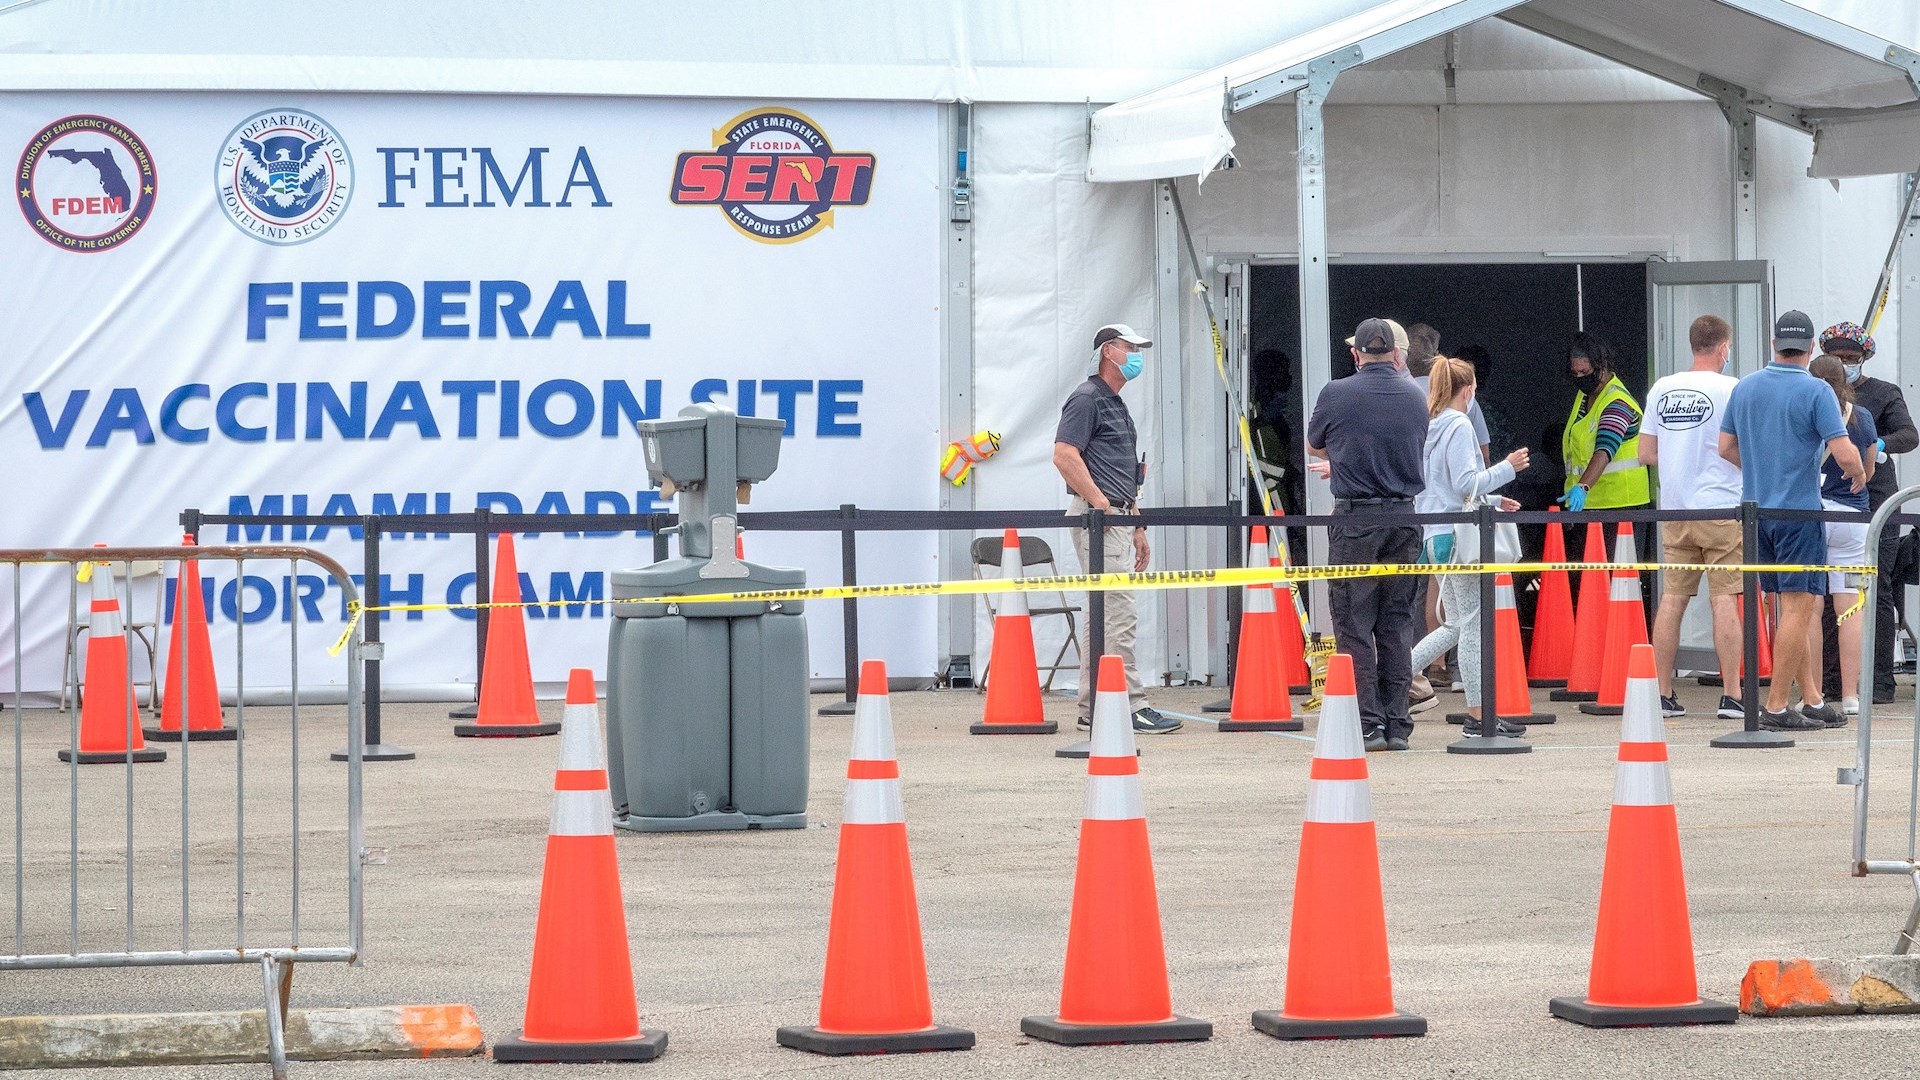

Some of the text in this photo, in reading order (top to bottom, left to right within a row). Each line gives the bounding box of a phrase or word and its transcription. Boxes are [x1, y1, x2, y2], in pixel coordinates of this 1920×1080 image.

[21, 119, 152, 180] DIVISION OF EMERGENCY MANAGEMENT
[222, 115, 347, 168] U.S. DEPARTMENT OF
[731, 117, 824, 149] STATE EMERGENCY
[750, 141, 801, 150] FLORIDA
[376, 146, 613, 208] FEMA
[678, 155, 872, 202] SERT
[52, 196, 124, 215] FDEM
[223, 182, 347, 239] HOMELAND SECURITY
[730, 205, 814, 235] RESPONSE TEAM
[35, 216, 142, 248] OFFICE OF THE GOVERNOR
[246, 280, 651, 342] FEDERAL
[22, 379, 662, 450] VACCINATION
[1657, 395, 1710, 416] Quiksilver
[227, 491, 673, 542] MIAMI DADE
[446, 571, 612, 620] CAM
